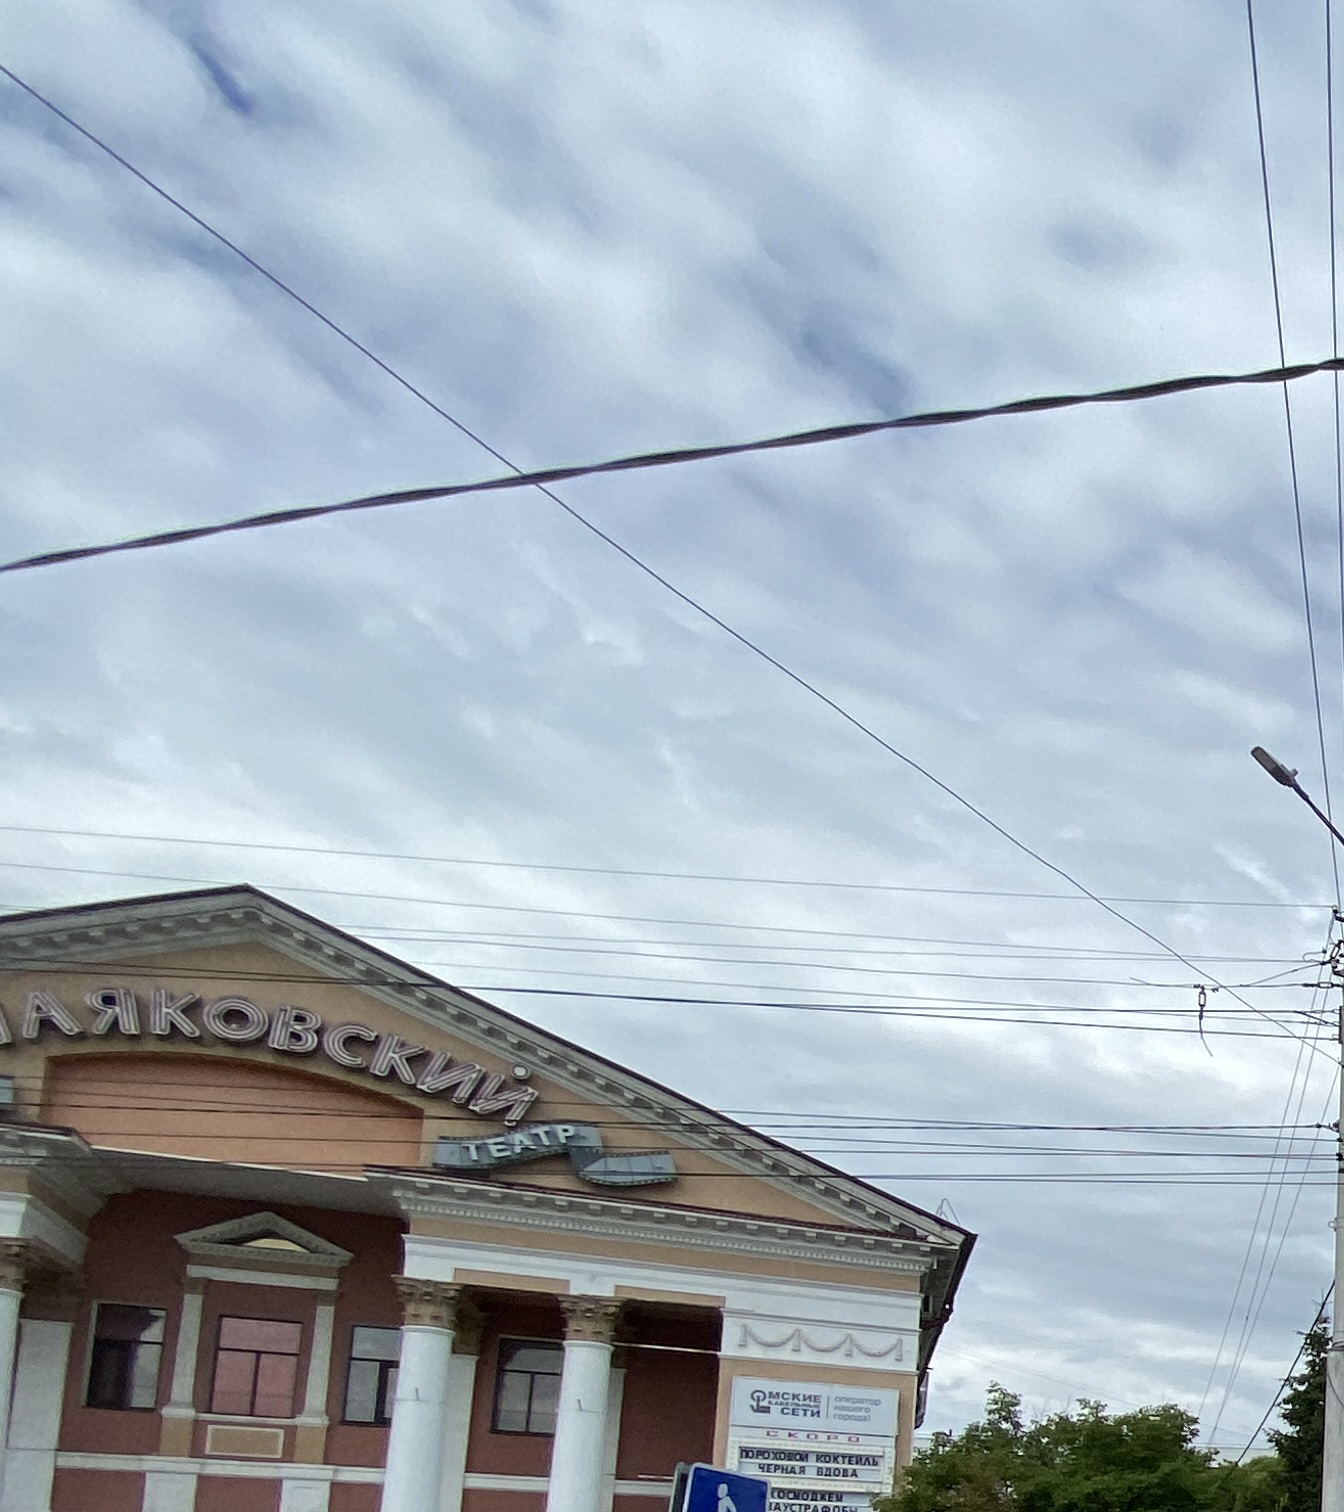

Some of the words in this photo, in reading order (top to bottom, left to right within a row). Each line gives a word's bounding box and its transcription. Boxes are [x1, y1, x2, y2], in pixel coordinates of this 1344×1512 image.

[0, 988, 538, 1126] АЯКОВСКИЙ
[462, 1124, 576, 1161] ТЕАТР
[780, 1407, 821, 1418] СЕТИ
[766, 1430, 859, 1443] СКОРО
[758, 1463, 806, 1475] ЧЕРНАЯ
[816, 1466, 859, 1478] ВДОВА
